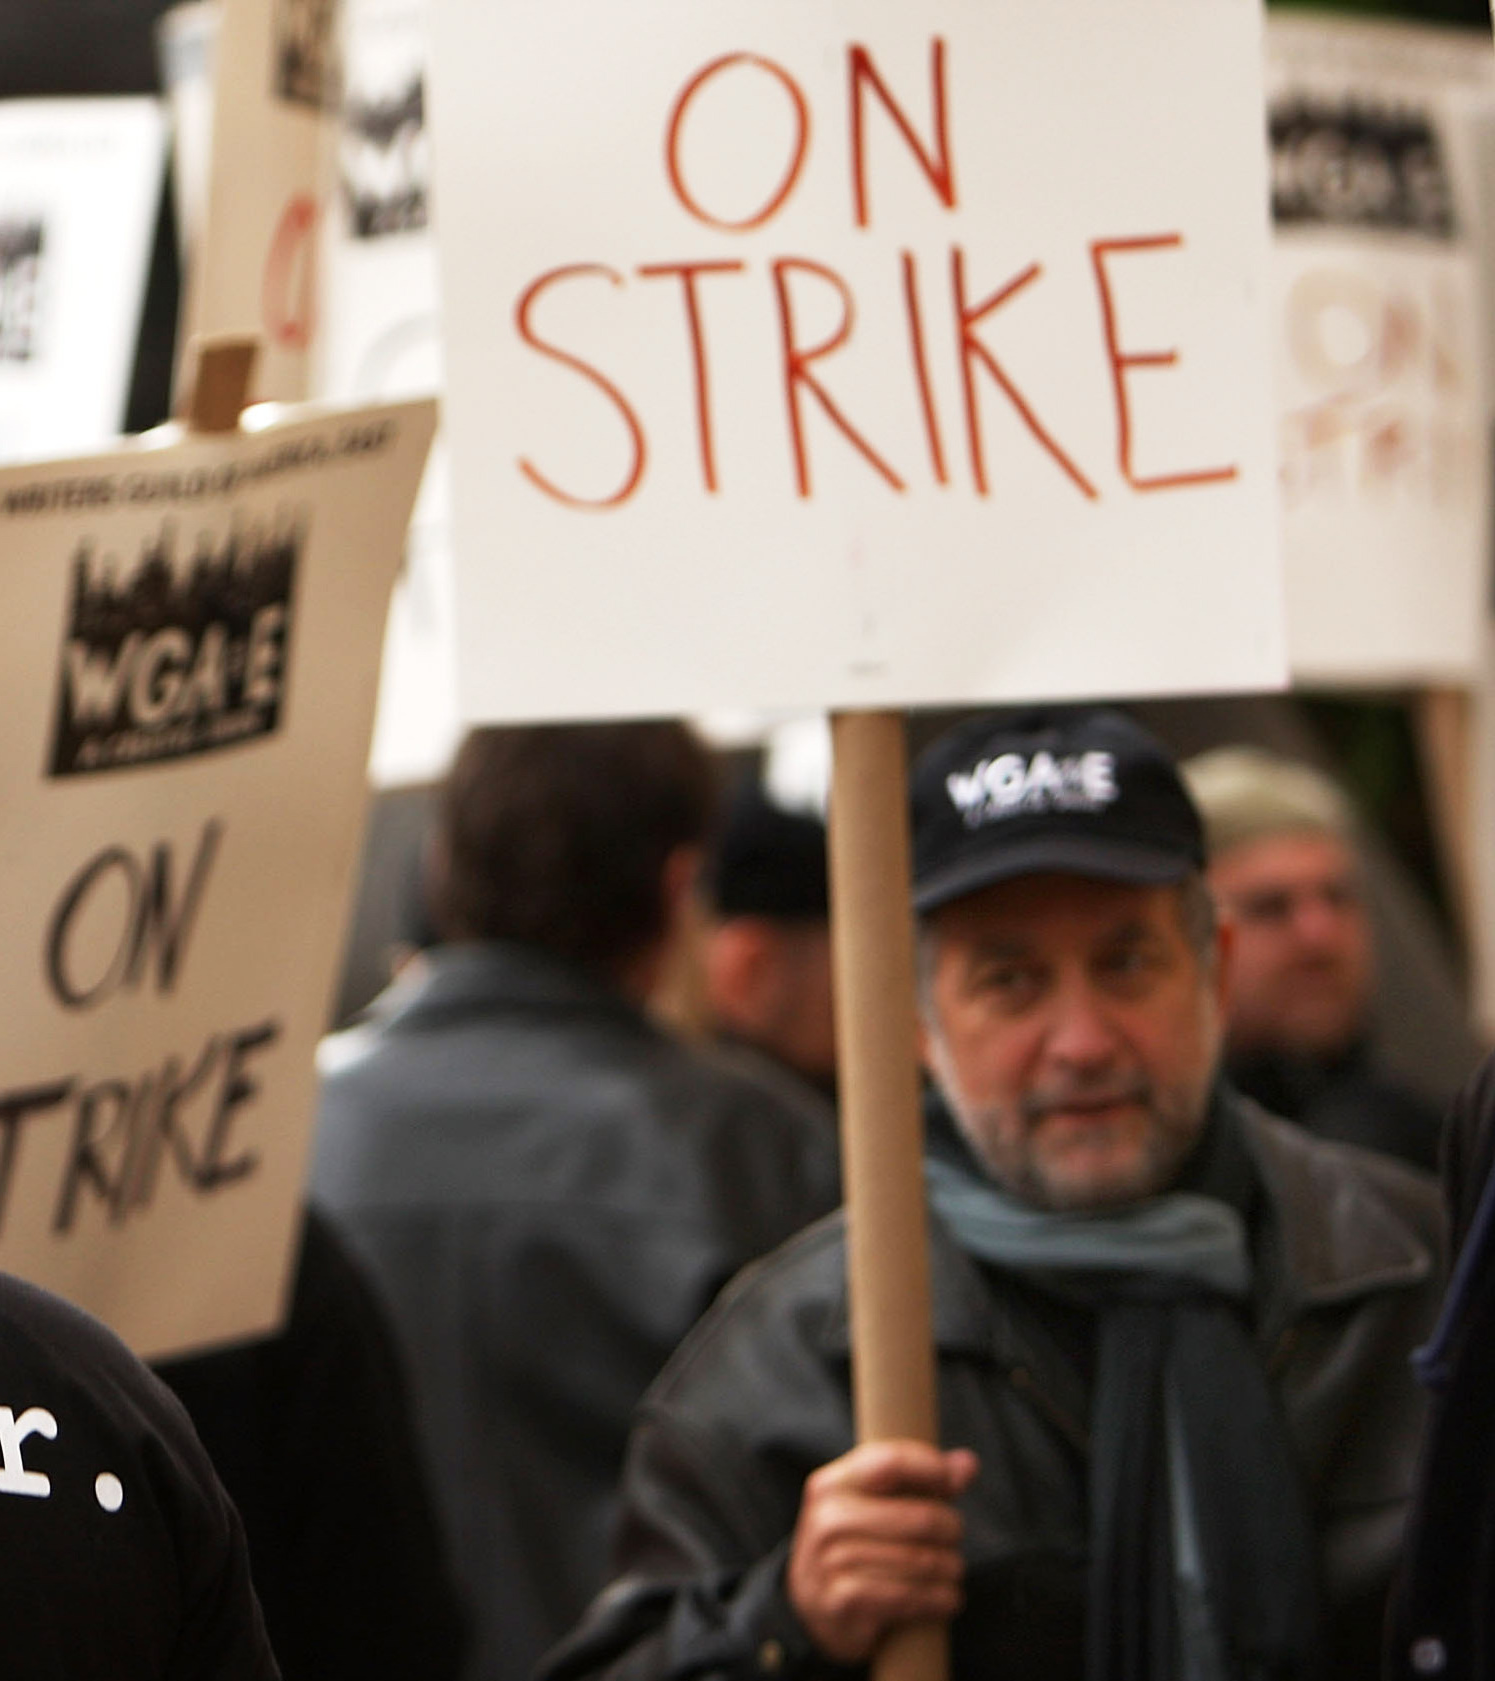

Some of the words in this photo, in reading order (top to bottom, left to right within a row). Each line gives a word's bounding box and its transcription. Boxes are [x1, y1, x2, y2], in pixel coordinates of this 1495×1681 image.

[665, 35, 958, 232] ON
[513, 231, 1239, 513] STRIKE
[44, 814, 226, 1012] ON
